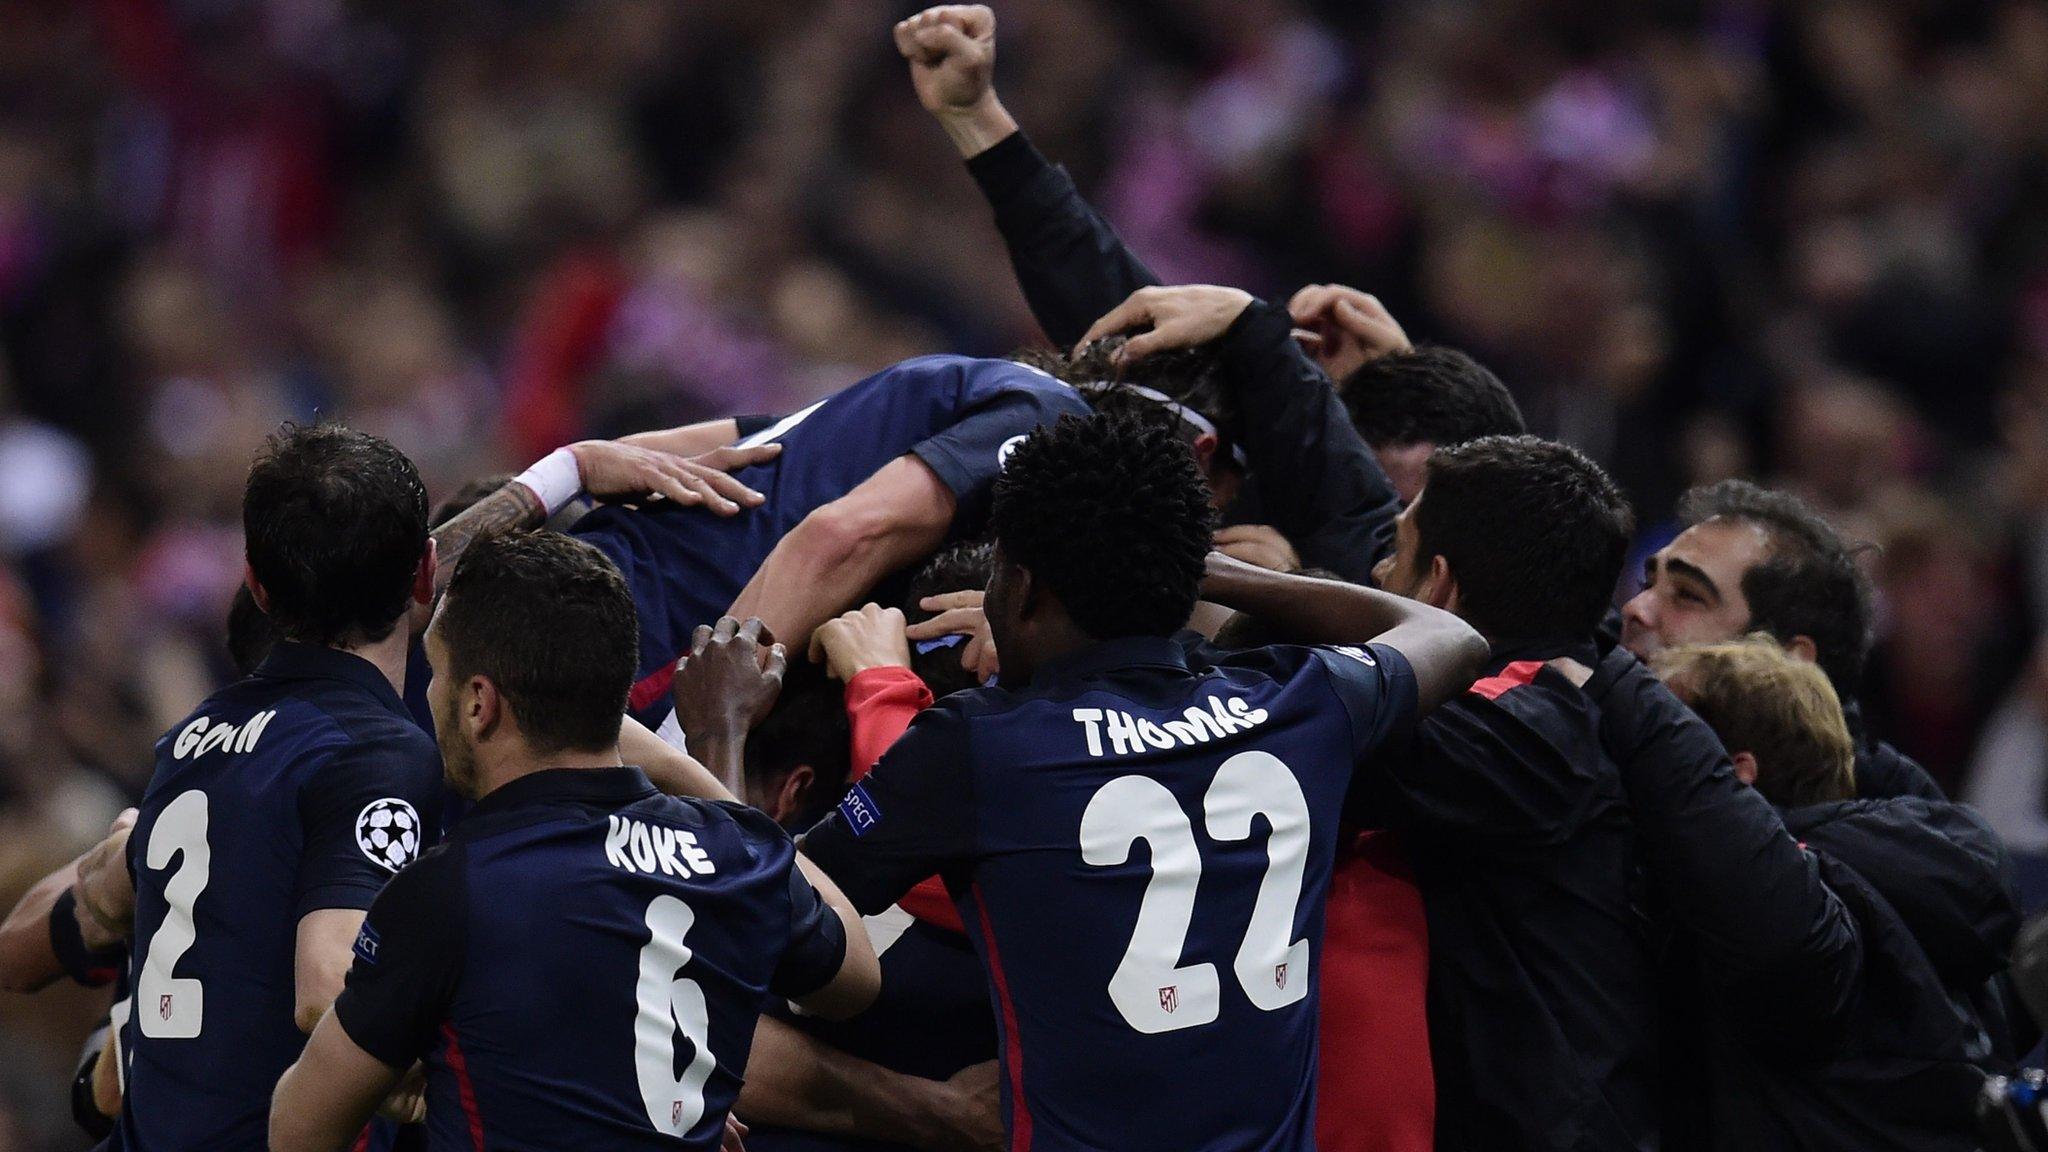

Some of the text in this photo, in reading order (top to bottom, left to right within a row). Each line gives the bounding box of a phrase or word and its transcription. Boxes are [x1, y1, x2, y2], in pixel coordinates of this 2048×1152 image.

[604, 814, 716, 880] KOKE
[1072, 695, 1269, 757] THOMAS
[138, 789, 211, 1039] 2
[1079, 750, 1311, 1034] 22
[634, 894, 717, 1138] 6
